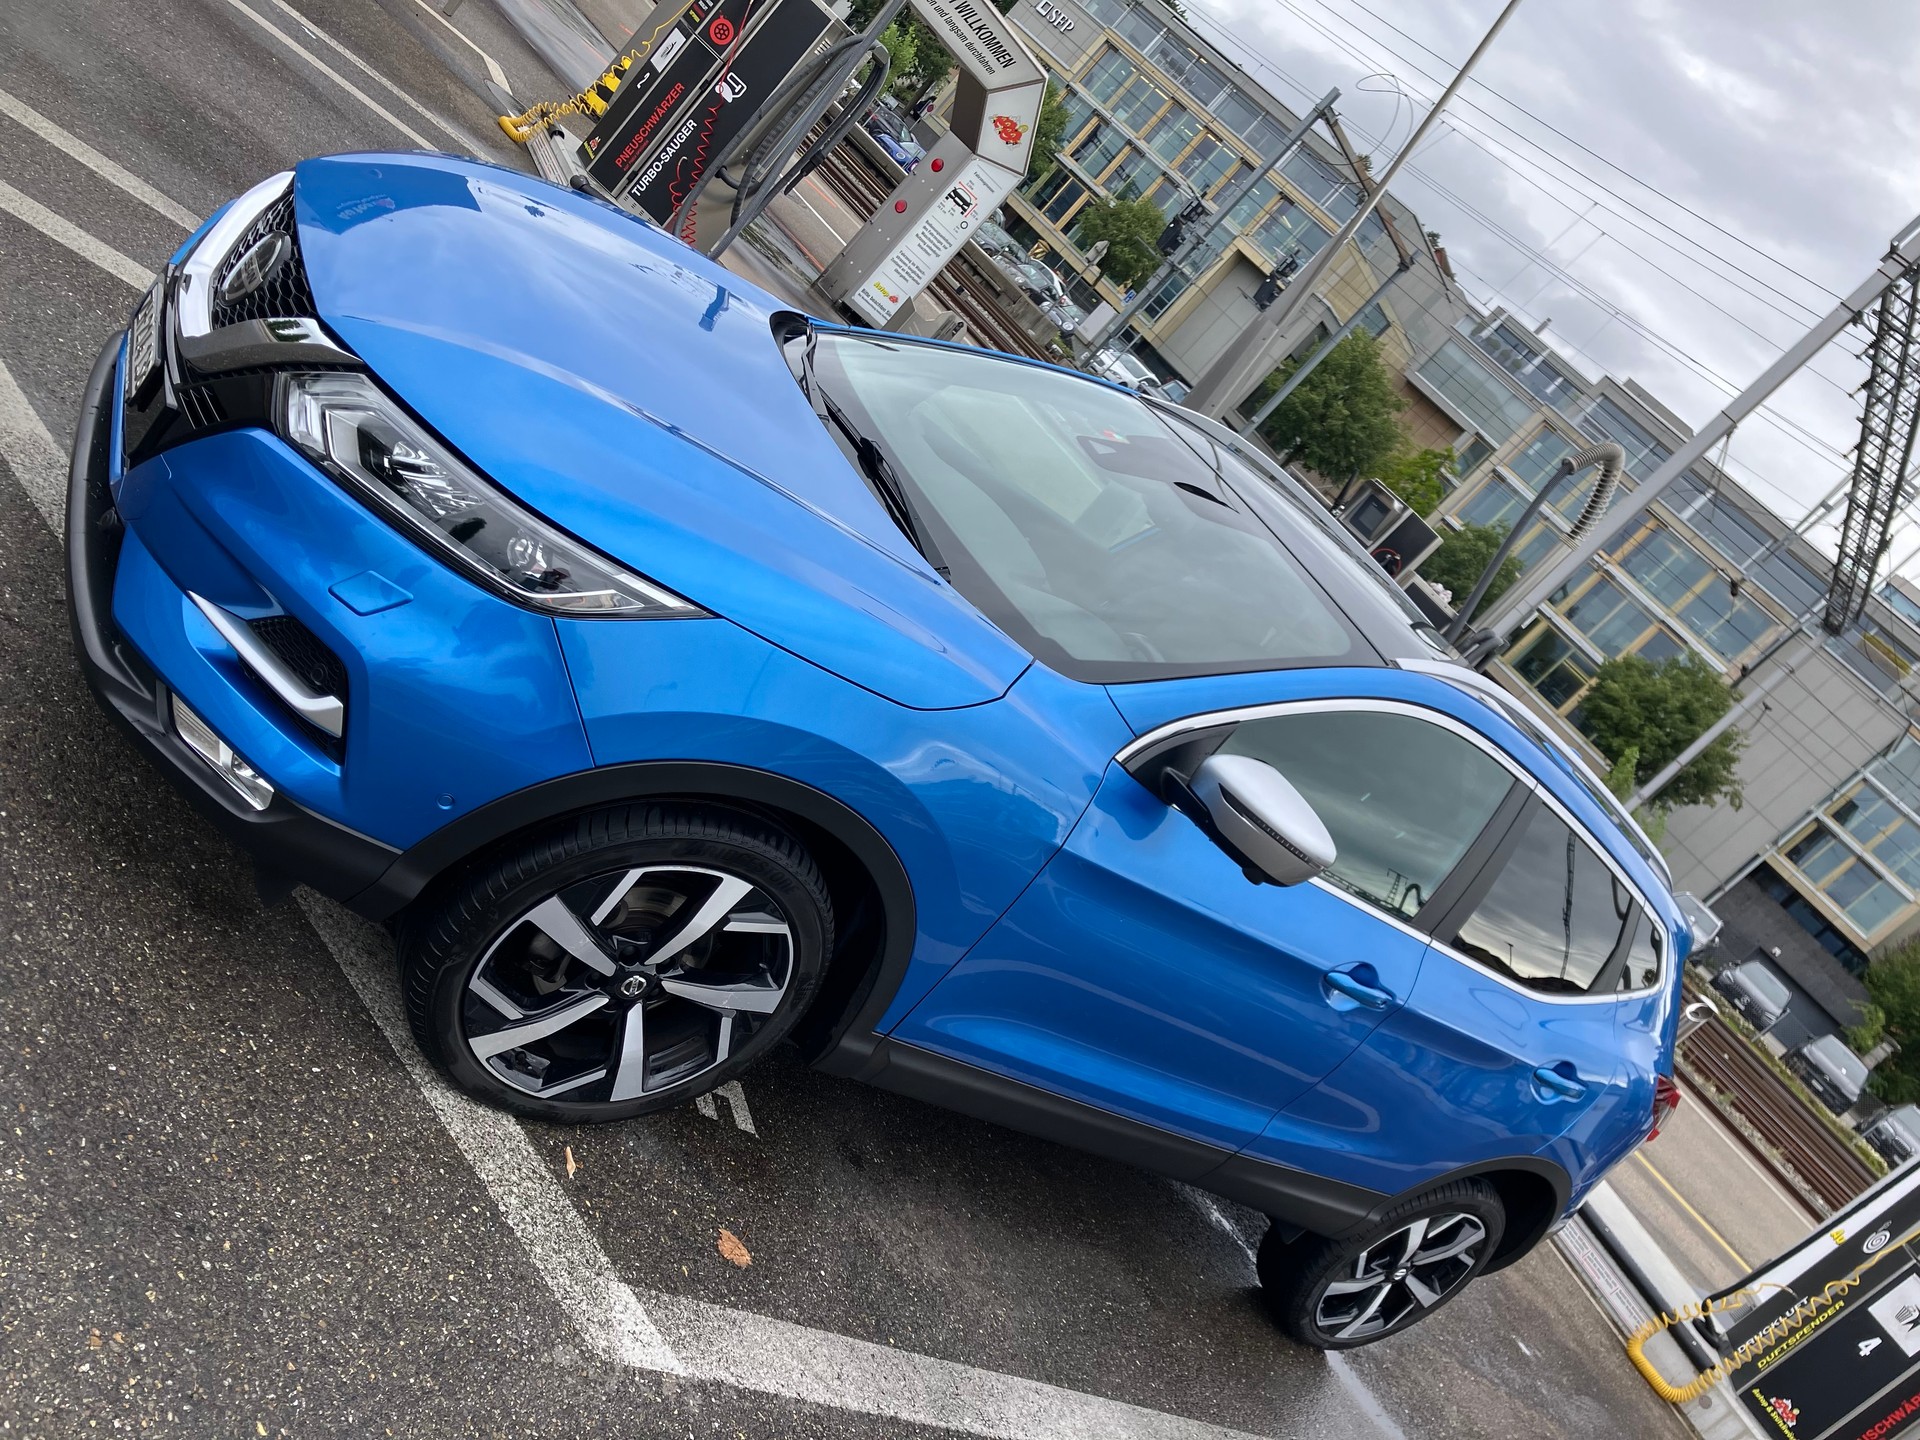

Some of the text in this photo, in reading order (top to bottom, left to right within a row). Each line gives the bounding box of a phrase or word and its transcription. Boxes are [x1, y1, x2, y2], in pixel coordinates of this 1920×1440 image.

[934, 2, 949, 18] und
[945, 14, 968, 44] langsam
[965, 37, 996, 76] durchfahren
[954, 1, 1016, 69] WILLKOMMEN
[1046, 8, 1075, 33] SFP
[615, 82, 685, 168] PNEUSCHWÄRZER
[631, 119, 697, 197] TURBO-SAUGER
[1757, 1300, 1845, 1369] DUFTSPENDER
[1858, 1336, 1883, 1357] 4
